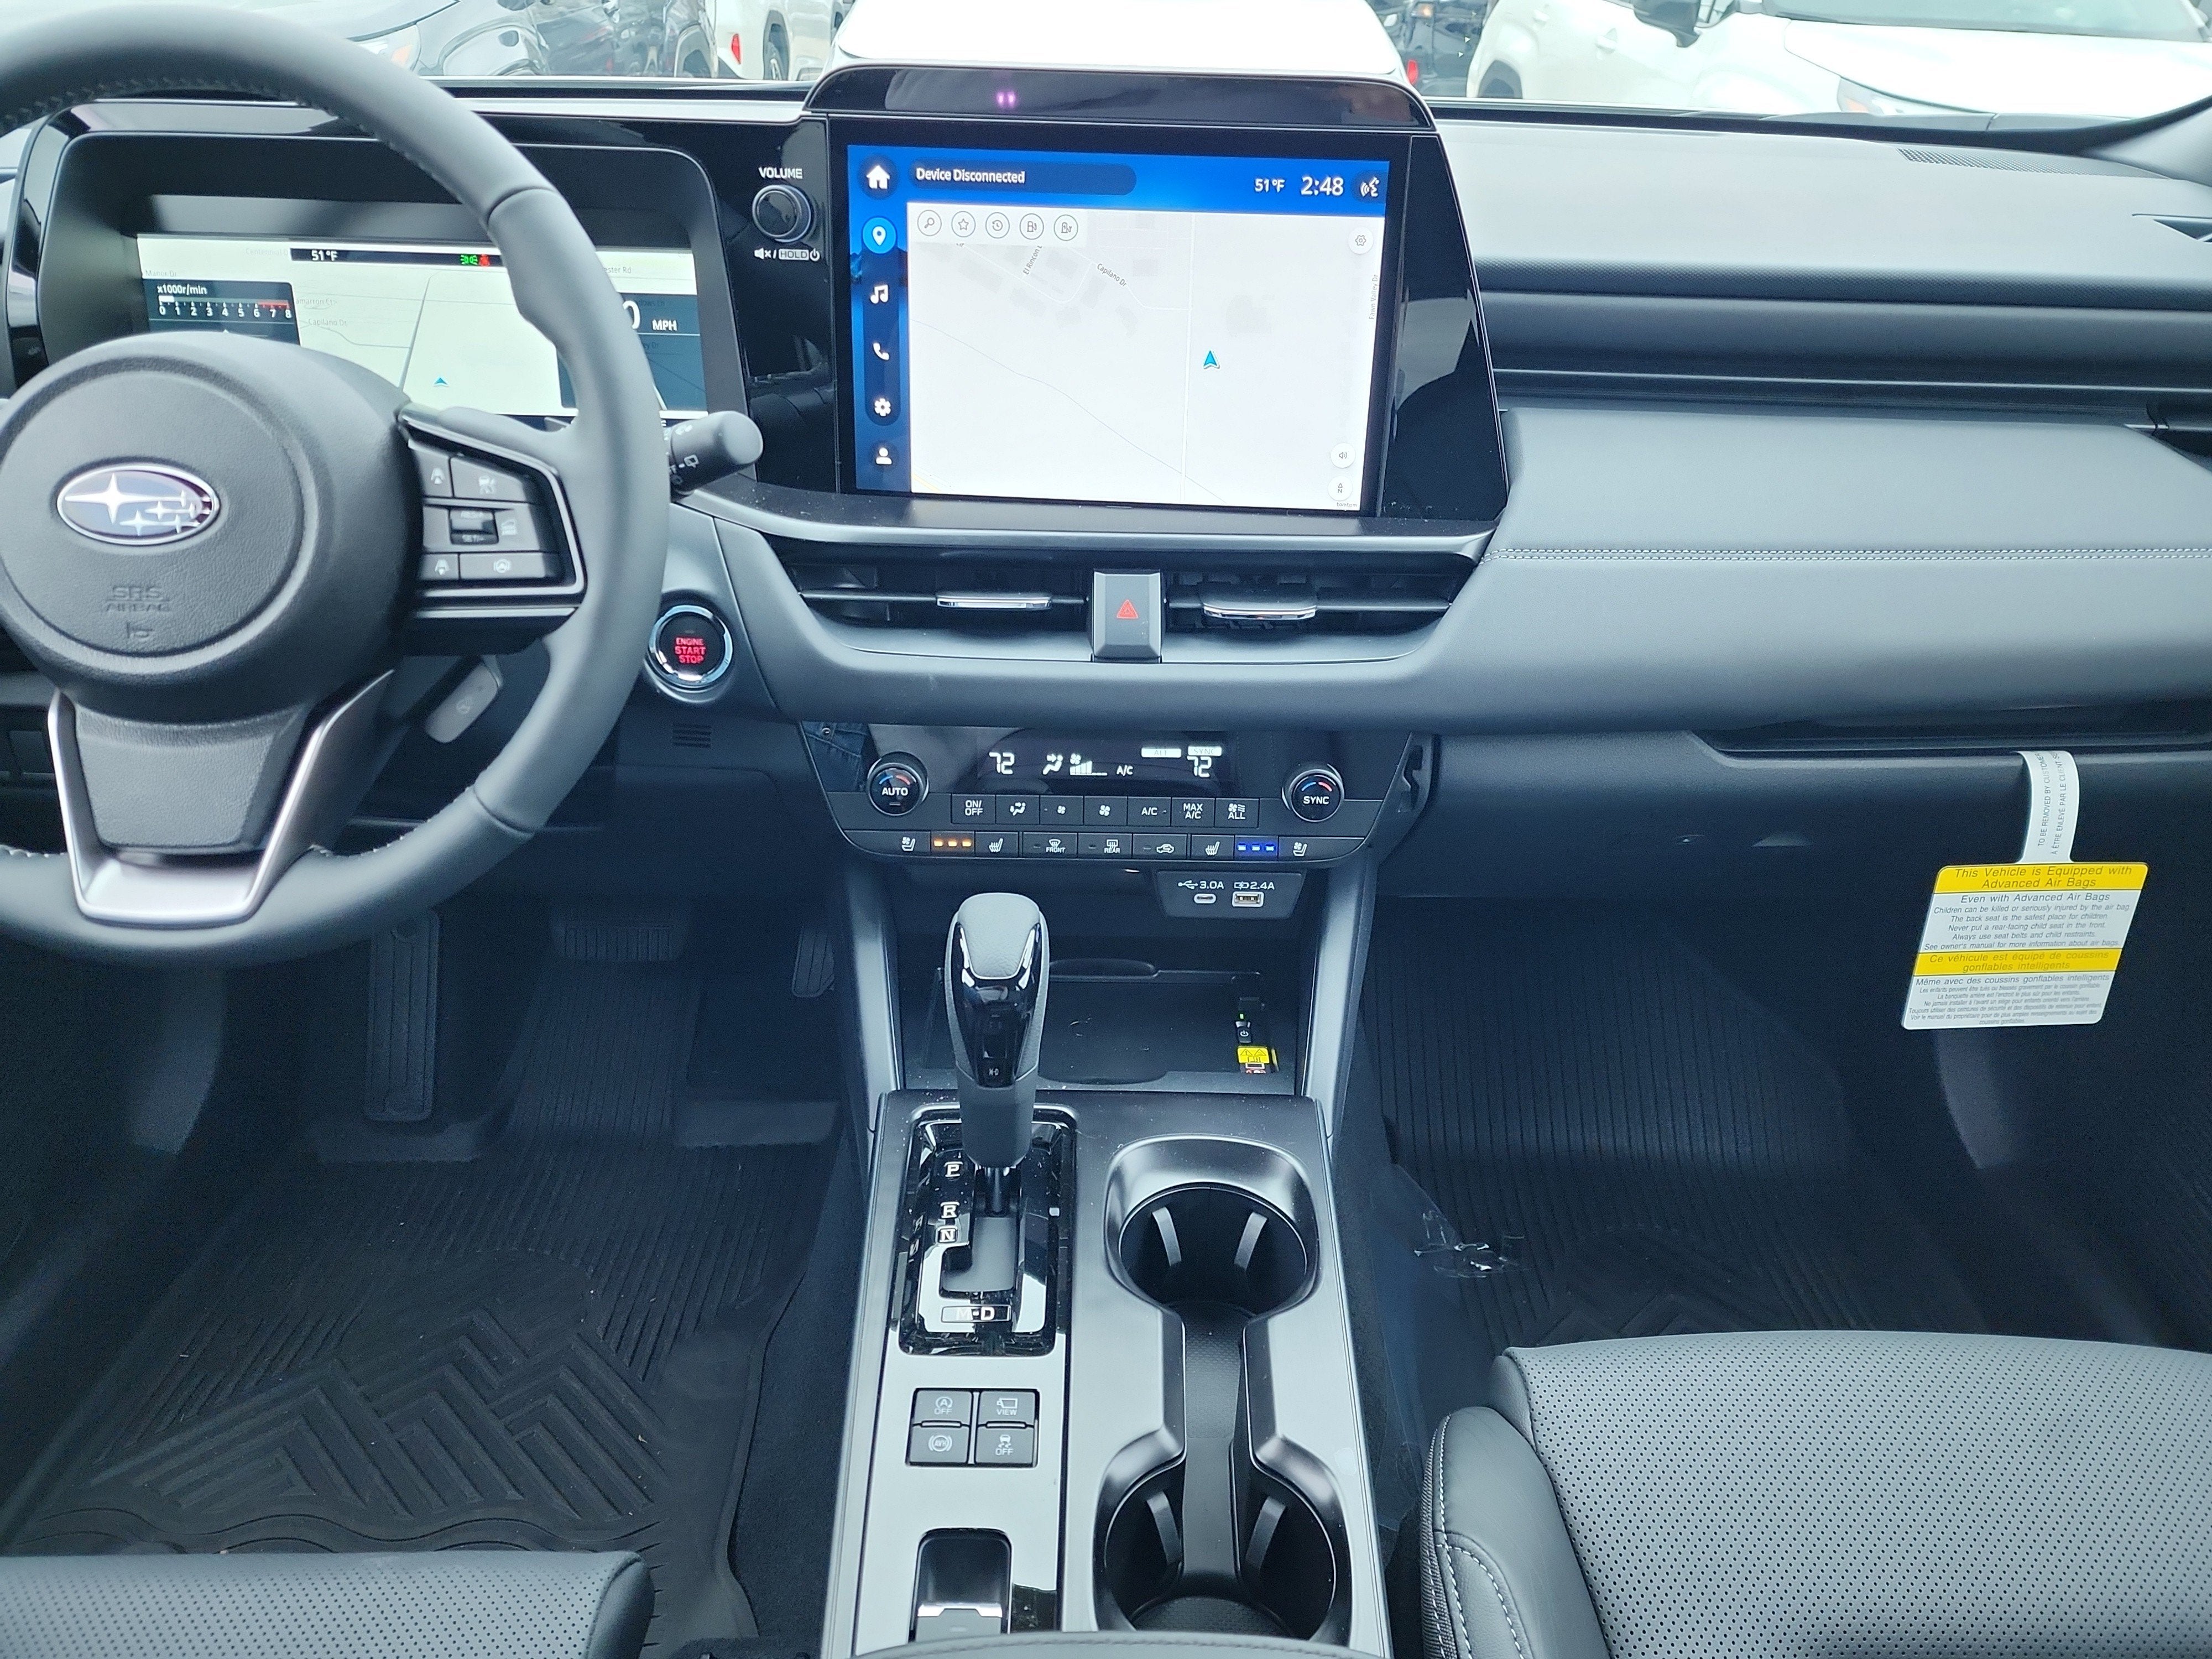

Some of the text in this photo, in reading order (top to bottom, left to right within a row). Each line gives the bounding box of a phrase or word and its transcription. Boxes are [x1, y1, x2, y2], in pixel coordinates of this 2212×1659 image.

[758, 167, 803, 179] VOLUME
[916, 168, 1025, 184] Device Disconnected
[1254, 178, 1285, 193] 51°F
[1301, 175, 1344, 196] 2:48
[311, 249, 338, 262] 51°F
[780, 251, 808, 259] HOLD
[157, 284, 207, 295] x1000r/min
[159, 306, 292, 319] 0 1 2 3 4 5 6 7 8
[651, 319, 678, 332] MPH
[675, 637, 704, 646] ENGINE
[674, 646, 706, 655] START
[679, 655, 704, 664] STOP
[989, 752, 1015, 775] 72
[1186, 756, 1212, 778] 72
[1117, 765, 1133, 775] A/C
[2056, 761, 2065, 781] CLIENT
[881, 787, 908, 797] AUTO
[965, 800, 982, 808] ON/
[1303, 795, 1329, 805] SYNC
[964, 807, 983, 816] OFF
[1141, 807, 1158, 816] A/C
[1183, 803, 1203, 811] MAX
[2042, 796, 2051, 826] REMOVED
[1185, 810, 1202, 820] A/C
[1228, 811, 1246, 820] ALL
[1955, 866, 2132, 878] This Vehicle is Equipped with
[1199, 881, 1275, 890] 3.0A 2.4A
[1981, 878, 2096, 888] Advanced Air Bags
[2013, 893, 2063, 901] Advanced
[2085, 893, 2110, 902] Bags
[2022, 905, 2051, 914] seriously
[1992, 923, 2028, 932] rear-facing
[1952, 933, 1976, 942] Always
[1948, 953, 1989, 962] véhicule
[2012, 952, 2045, 961] équipé
[2049, 951, 2062, 959] de
[2066, 951, 2109, 959] coussins
[1963, 962, 2070, 973] gonflables intelligents
[1916, 977, 1940, 985] Même
[2068, 973, 2109, 982] intelligents
[947, 1165, 960, 1176] P
[943, 1204, 957, 1217] R
[941, 1229, 956, 1243] N
